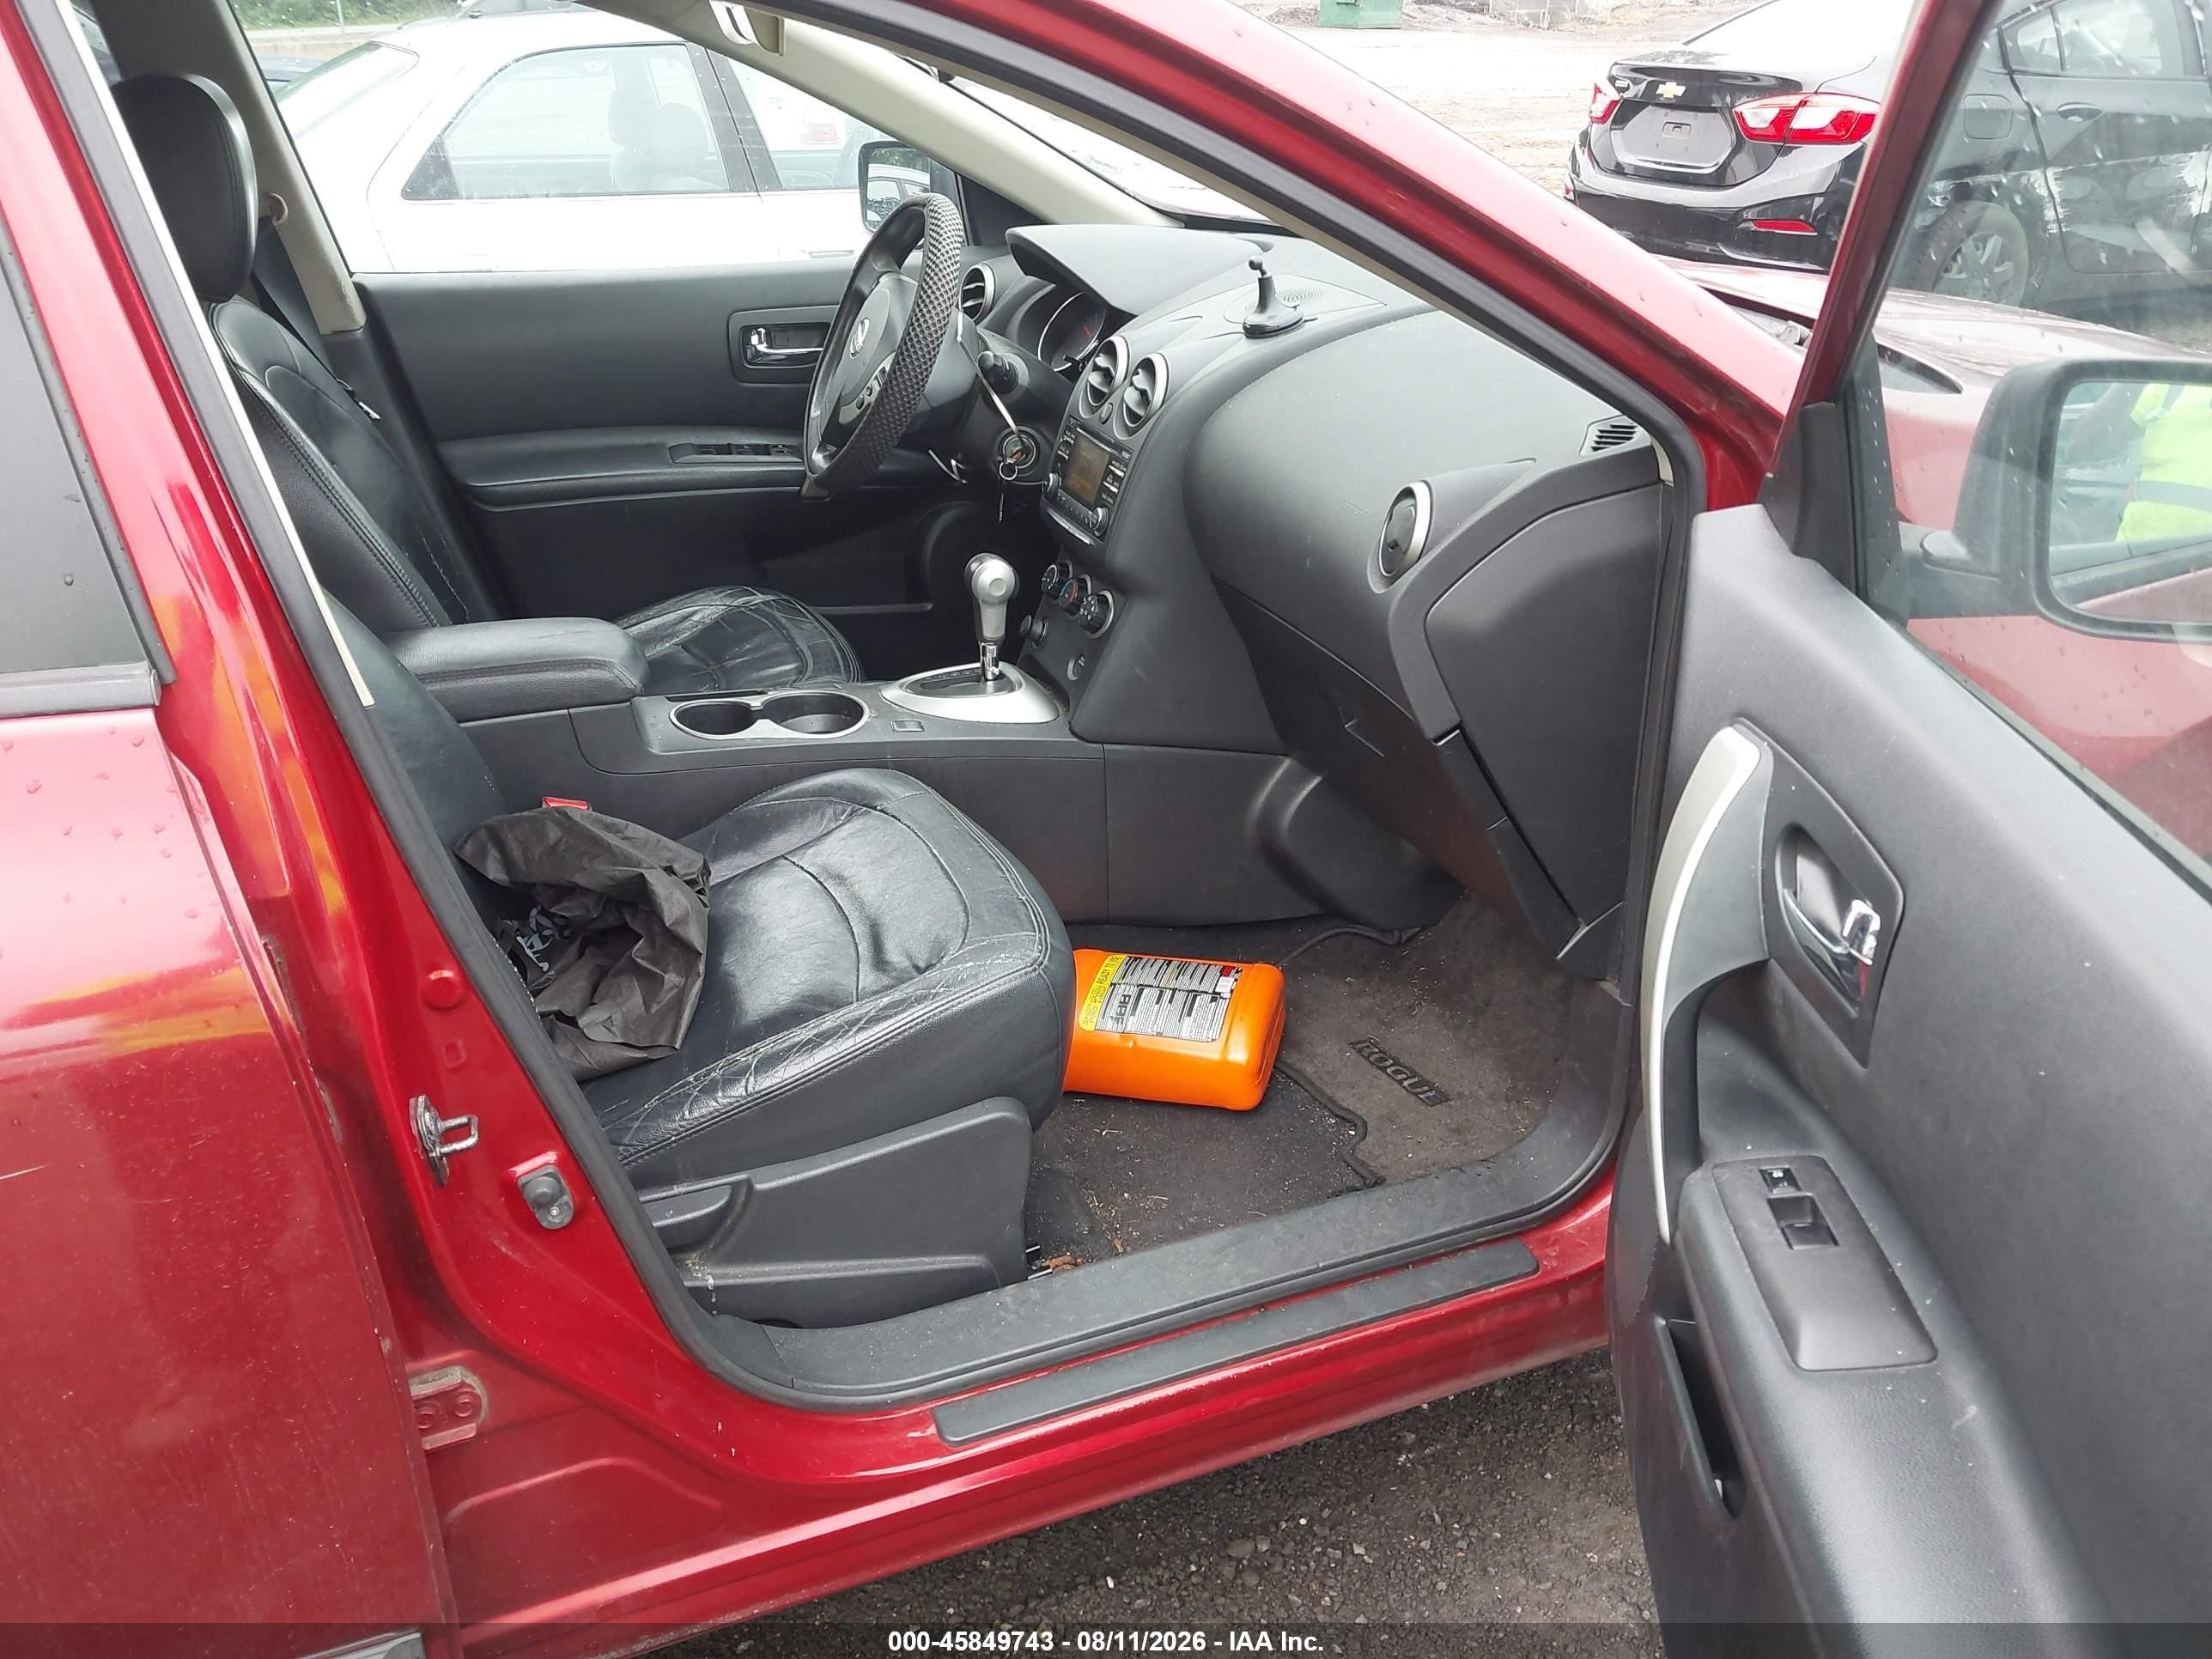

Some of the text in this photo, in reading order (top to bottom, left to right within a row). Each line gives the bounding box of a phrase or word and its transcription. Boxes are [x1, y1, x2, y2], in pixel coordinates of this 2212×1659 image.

[1097, 969, 1110, 985] READY
[1104, 961, 1115, 969] TO
[1354, 1041, 1444, 1107] ROGUE
